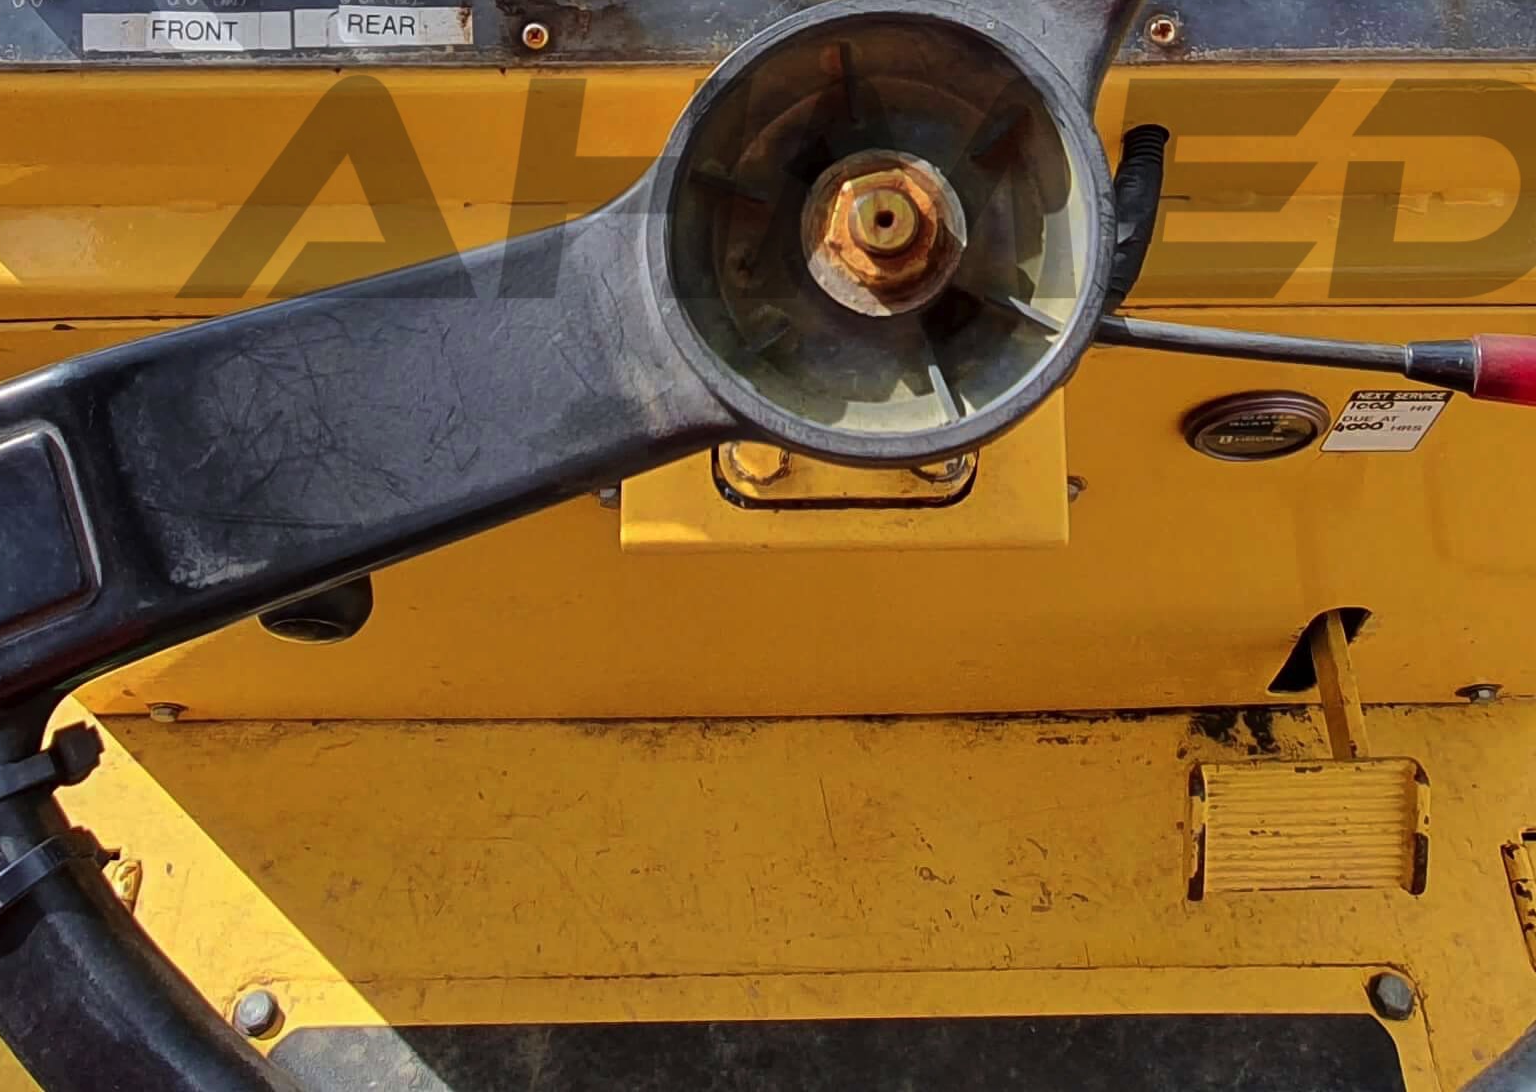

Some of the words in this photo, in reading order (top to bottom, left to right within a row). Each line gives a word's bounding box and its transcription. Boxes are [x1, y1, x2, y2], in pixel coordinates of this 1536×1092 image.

[150, 19, 239, 42] FRONT
[346, 13, 417, 37] REAR
[1355, 392, 1391, 401] NEXT
[1392, 391, 1448, 401] SERVICE
[1342, 415, 1374, 423] DUE
[1380, 414, 1401, 423] AT
